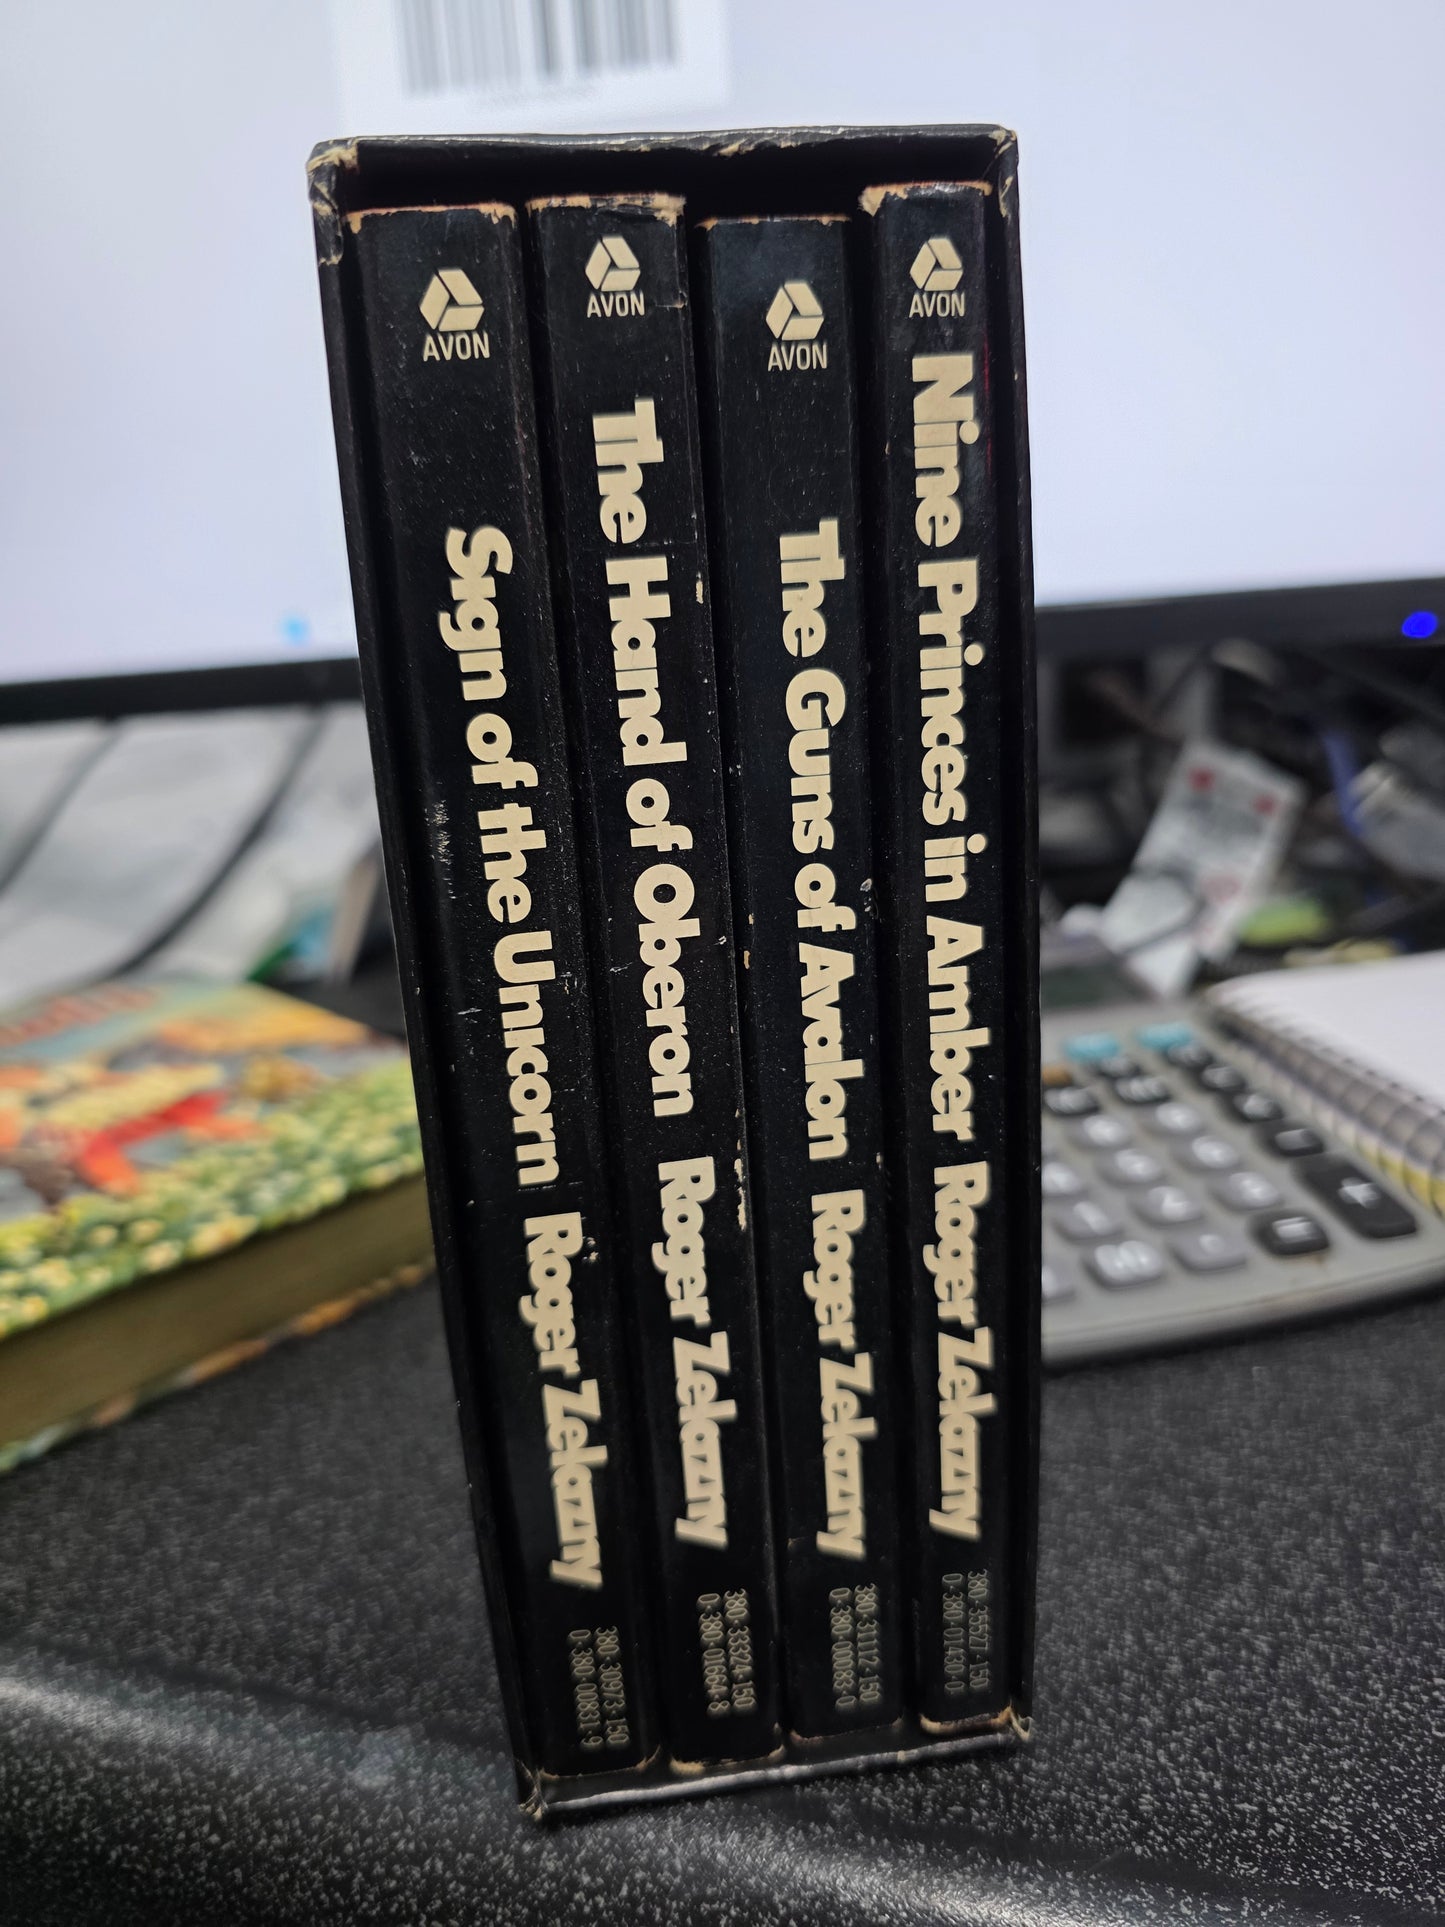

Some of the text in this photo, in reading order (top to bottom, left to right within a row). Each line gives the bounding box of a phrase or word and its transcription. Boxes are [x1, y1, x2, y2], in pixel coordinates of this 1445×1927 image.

[423, 332, 489, 361] AVON
[587, 290, 644, 317] AVON
[768, 343, 827, 371] AVON
[909, 290, 964, 317] AVON
[439, 527, 607, 1585] Sign of the Unicorn Roger Zelazny
[593, 399, 736, 1545] The Hand of Oberon Roger Zelazny
[780, 519, 875, 1556] The Guns of Avalon Roger Zelazny
[912, 354, 994, 1537] Nine Princes in Amber Roger Zelazny
